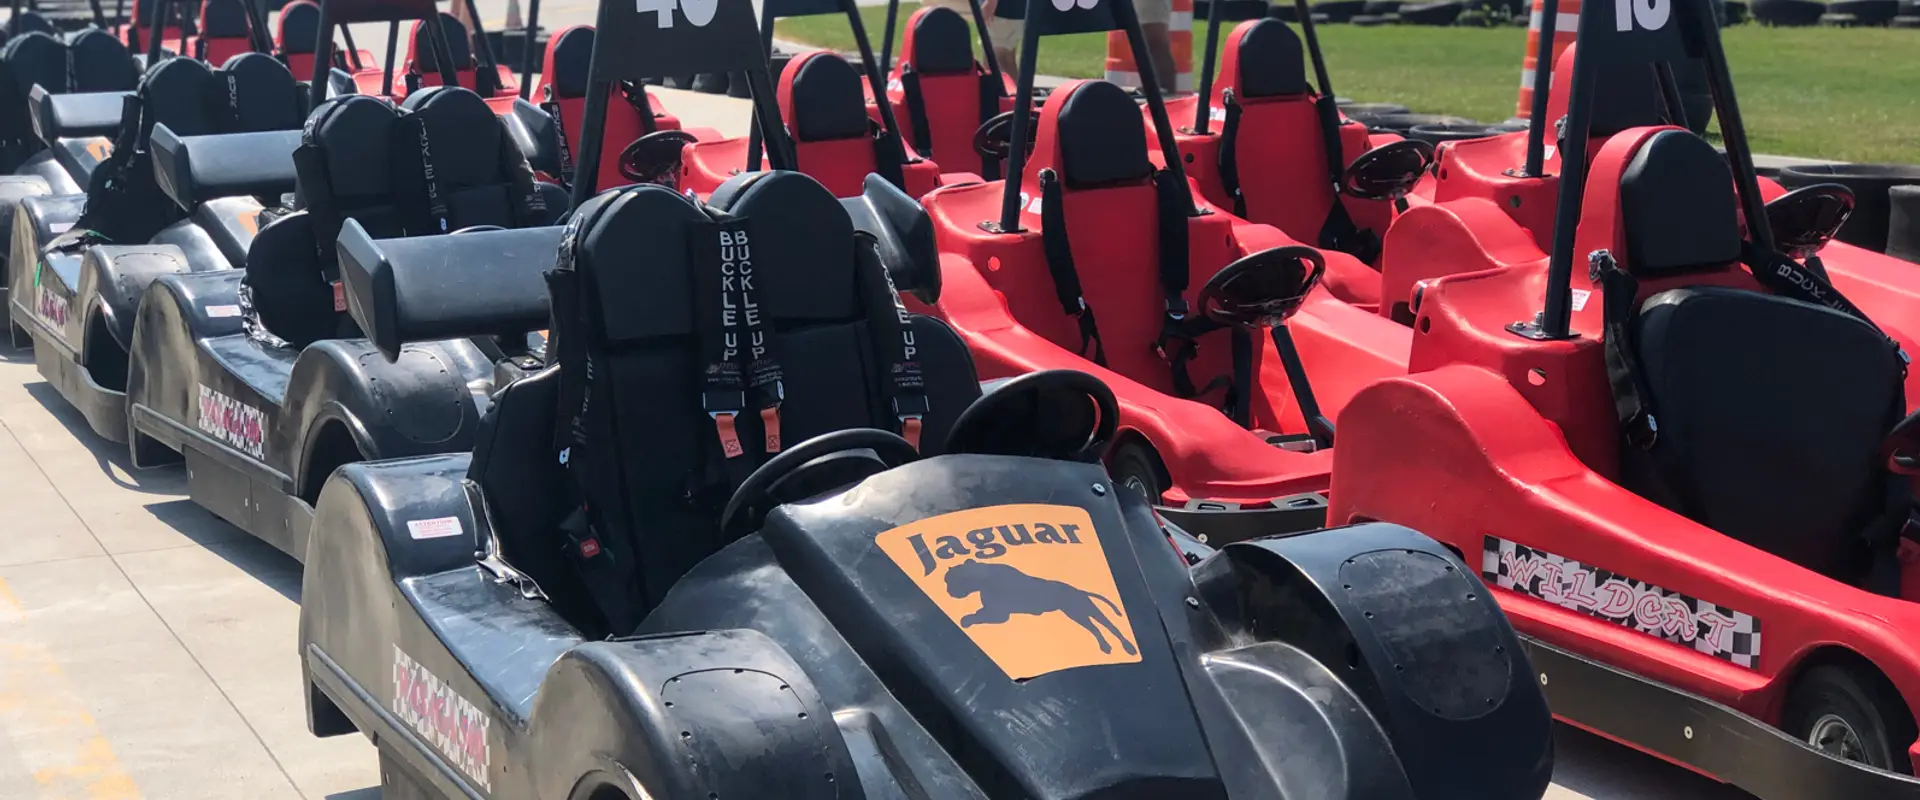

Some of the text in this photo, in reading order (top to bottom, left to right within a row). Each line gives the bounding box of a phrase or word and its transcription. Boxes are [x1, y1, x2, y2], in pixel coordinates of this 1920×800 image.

[719, 231, 737, 327] BUCKLE
[735, 230, 765, 360] BUCKLE UP
[723, 332, 738, 361] UP
[903, 331, 917, 360] UP
[905, 522, 1084, 578] Jaguar
[1500, 551, 1737, 650] WILDCAT
